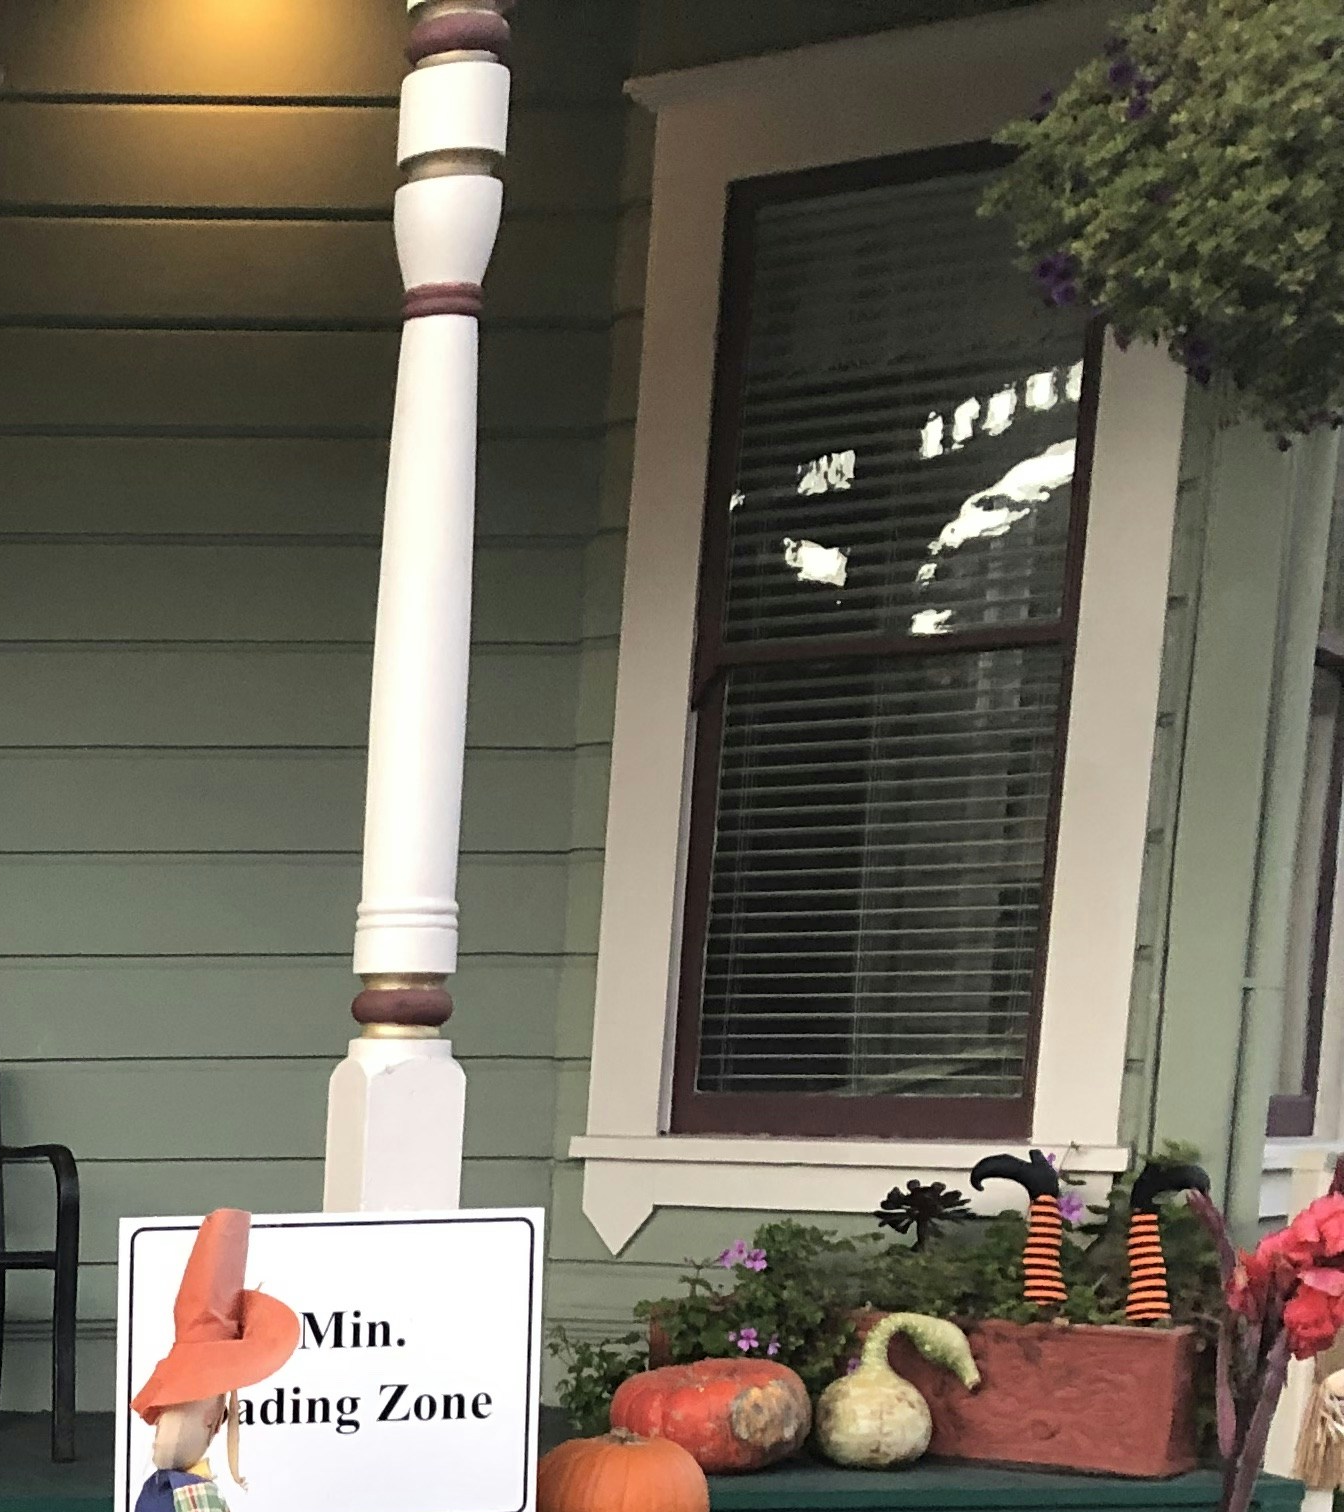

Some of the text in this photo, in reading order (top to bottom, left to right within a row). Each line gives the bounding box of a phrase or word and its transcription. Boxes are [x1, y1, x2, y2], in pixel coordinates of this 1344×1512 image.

[298, 1310, 406, 1350] Min.
[221, 1384, 494, 1435] ading Zone
